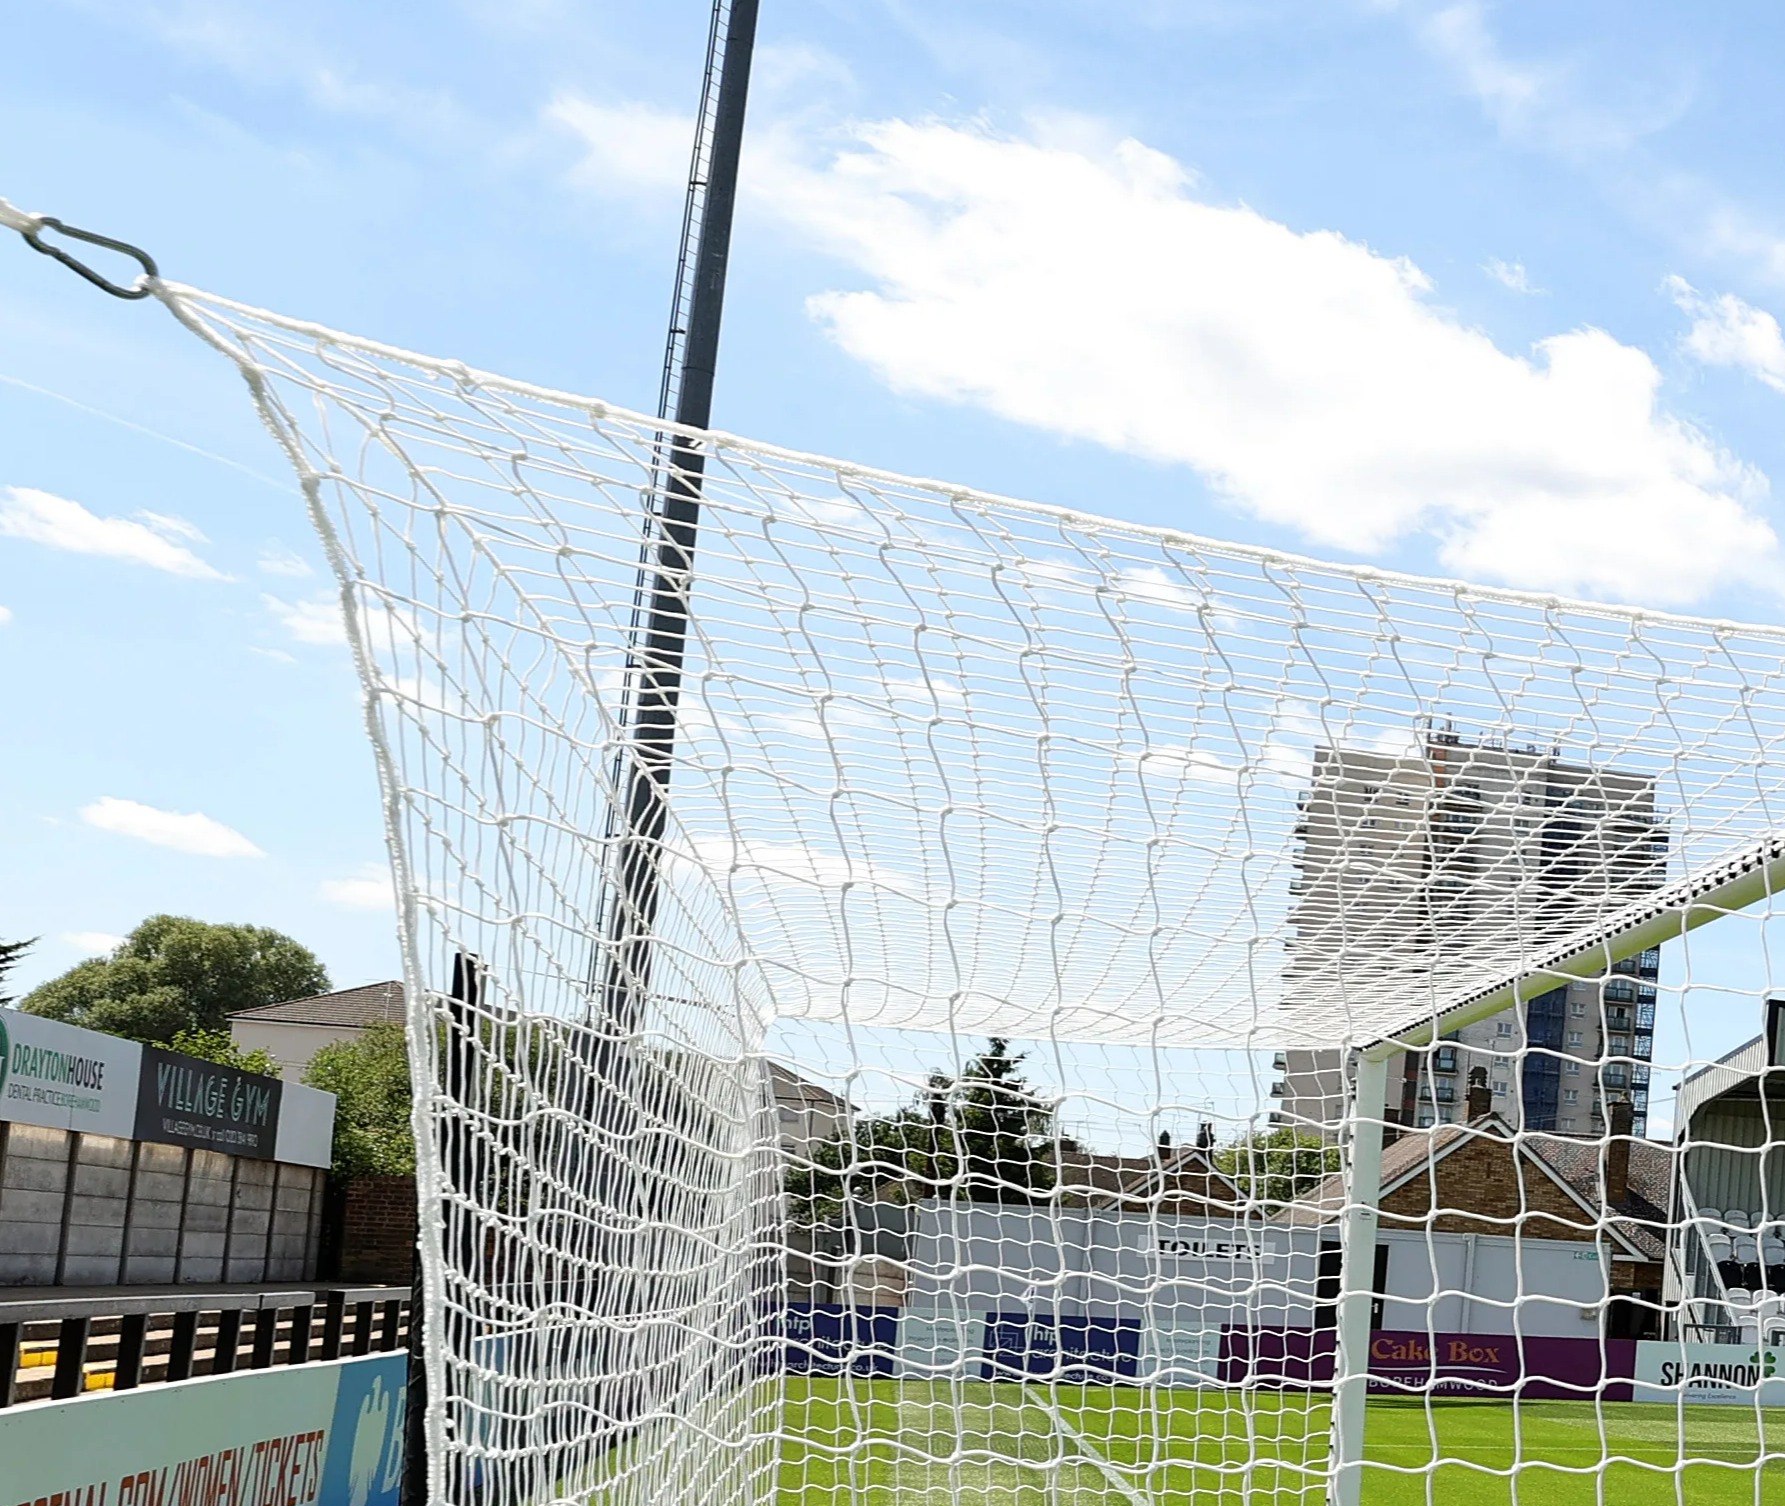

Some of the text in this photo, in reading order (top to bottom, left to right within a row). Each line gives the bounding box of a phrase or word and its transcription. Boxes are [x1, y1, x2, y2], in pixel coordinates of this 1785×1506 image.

[12, 1043, 105, 1091] DRAYTONHOUSE
[158, 1062, 271, 1126] VILLAGE GYM
[1158, 1240, 1261, 1260] TOILETS
[1371, 1338, 1500, 1363] Cake Box
[1660, 1361, 1761, 1389] SHANNON
